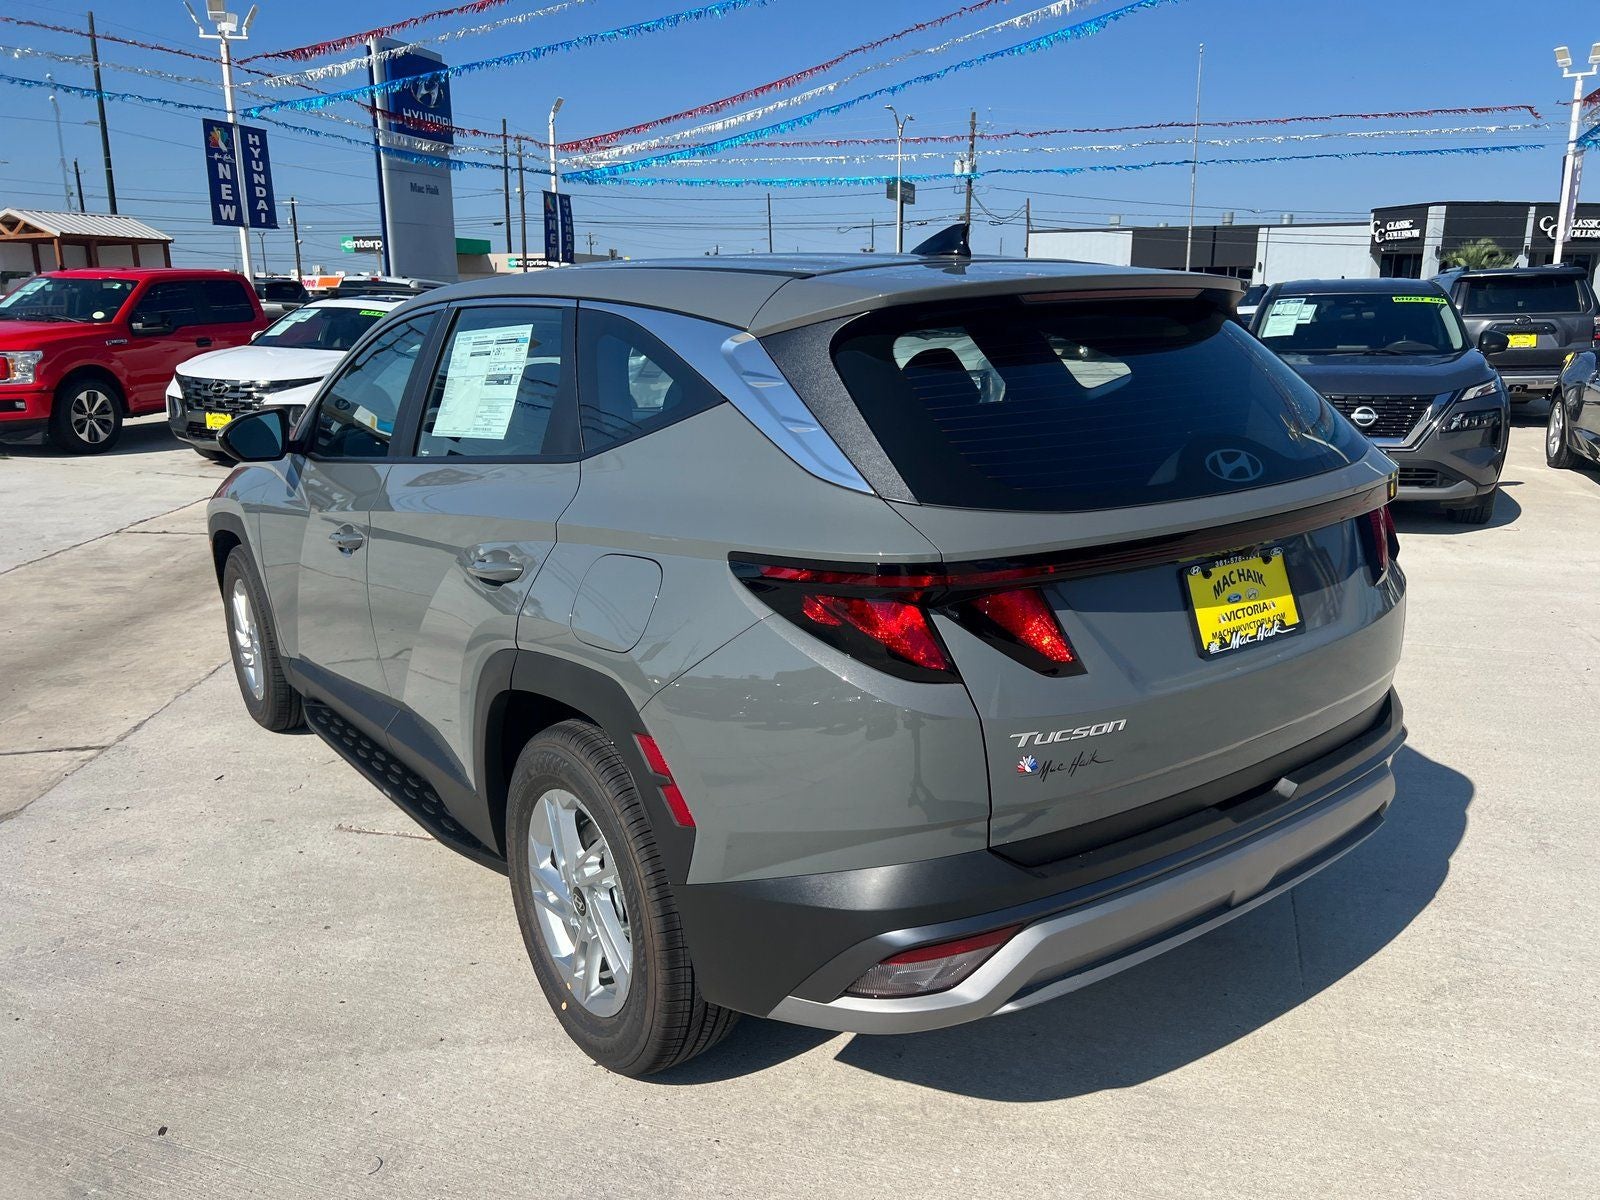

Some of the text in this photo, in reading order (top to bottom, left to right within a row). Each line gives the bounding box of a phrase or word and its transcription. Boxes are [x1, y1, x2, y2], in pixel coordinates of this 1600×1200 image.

[247, 133, 269, 223] HYUNDAI
[217, 162, 237, 221] NEW
[1386, 219, 1414, 231] CLASSIC
[1571, 218, 1600, 229] LASSIC
[1385, 228, 1421, 241] COLLISION
[340, 238, 384, 251] enterp
[1212, 568, 1267, 600] MAC HAIK
[1224, 601, 1269, 622] VICTORIA
[1229, 631, 1257, 649] Mac
